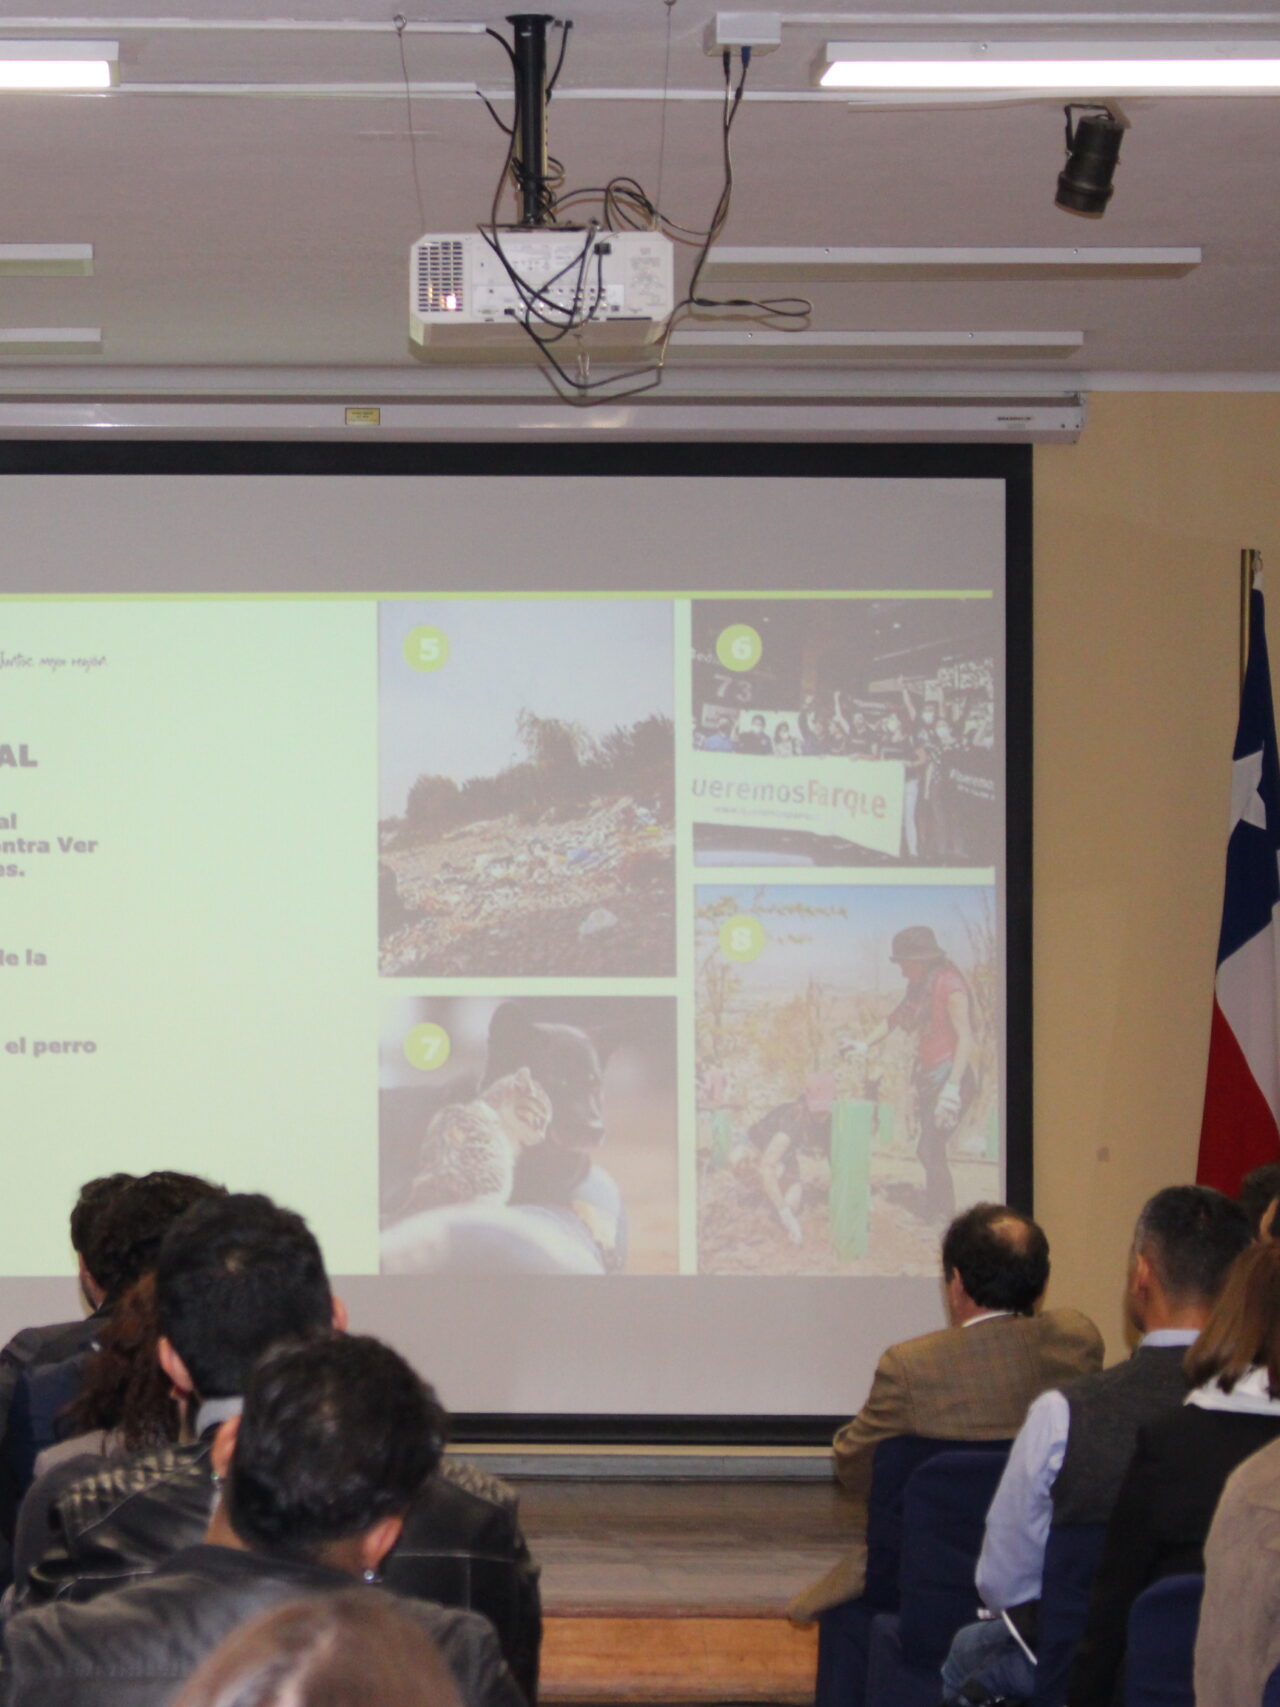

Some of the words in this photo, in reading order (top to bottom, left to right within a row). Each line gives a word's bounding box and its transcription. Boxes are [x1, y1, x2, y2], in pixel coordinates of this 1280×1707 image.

[420, 638, 439, 660] 5
[731, 637, 752, 659] 6
[57, 837, 99, 854] Ver
[730, 927, 752, 950] 8
[26, 949, 48, 966] la
[5, 1037, 26, 1054] el
[33, 1040, 98, 1058] perro
[421, 1038, 441, 1060] 7
